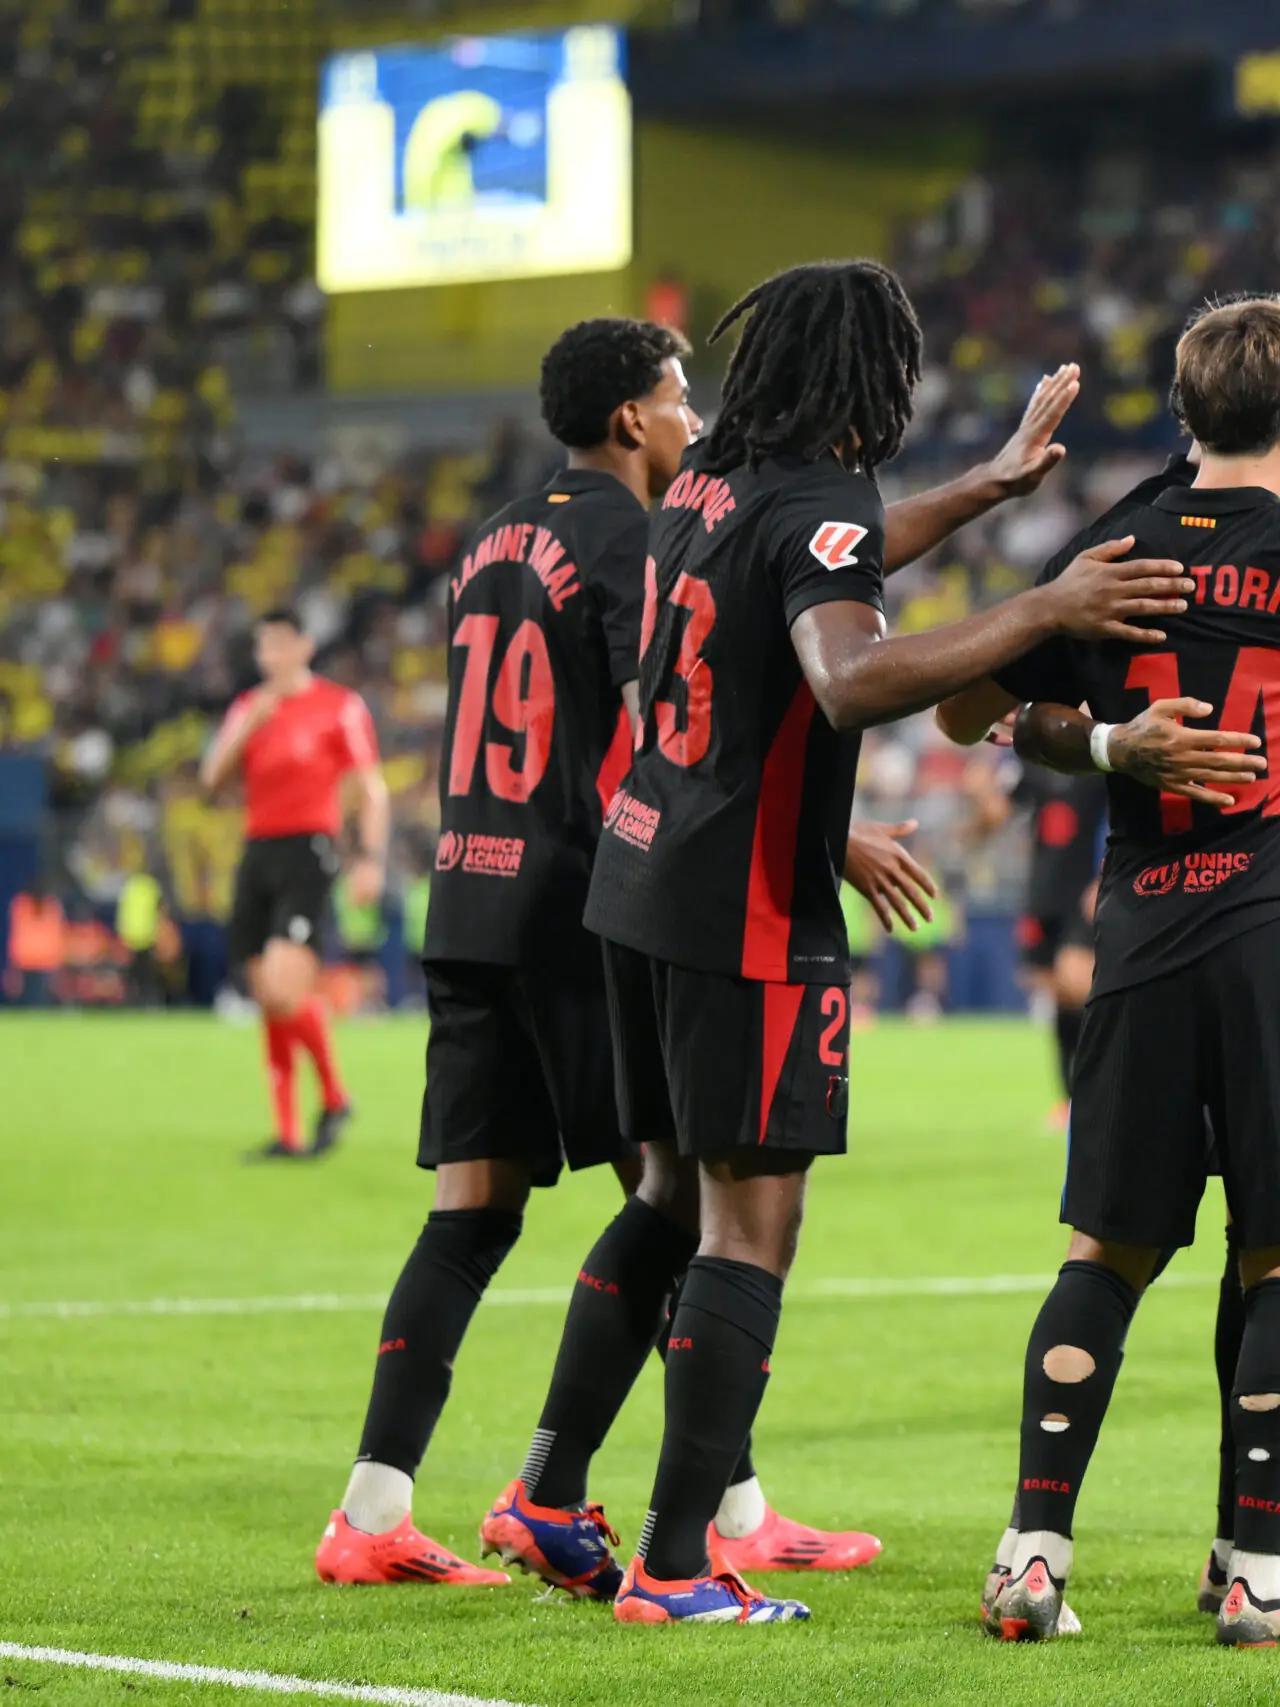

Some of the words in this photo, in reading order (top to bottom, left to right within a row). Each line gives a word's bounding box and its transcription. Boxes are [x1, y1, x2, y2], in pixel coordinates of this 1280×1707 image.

[448, 612, 555, 804] 19
[466, 833, 526, 856] UNHCR
[1184, 852, 1255, 872] UNHC
[1183, 868, 1236, 886] ACN
